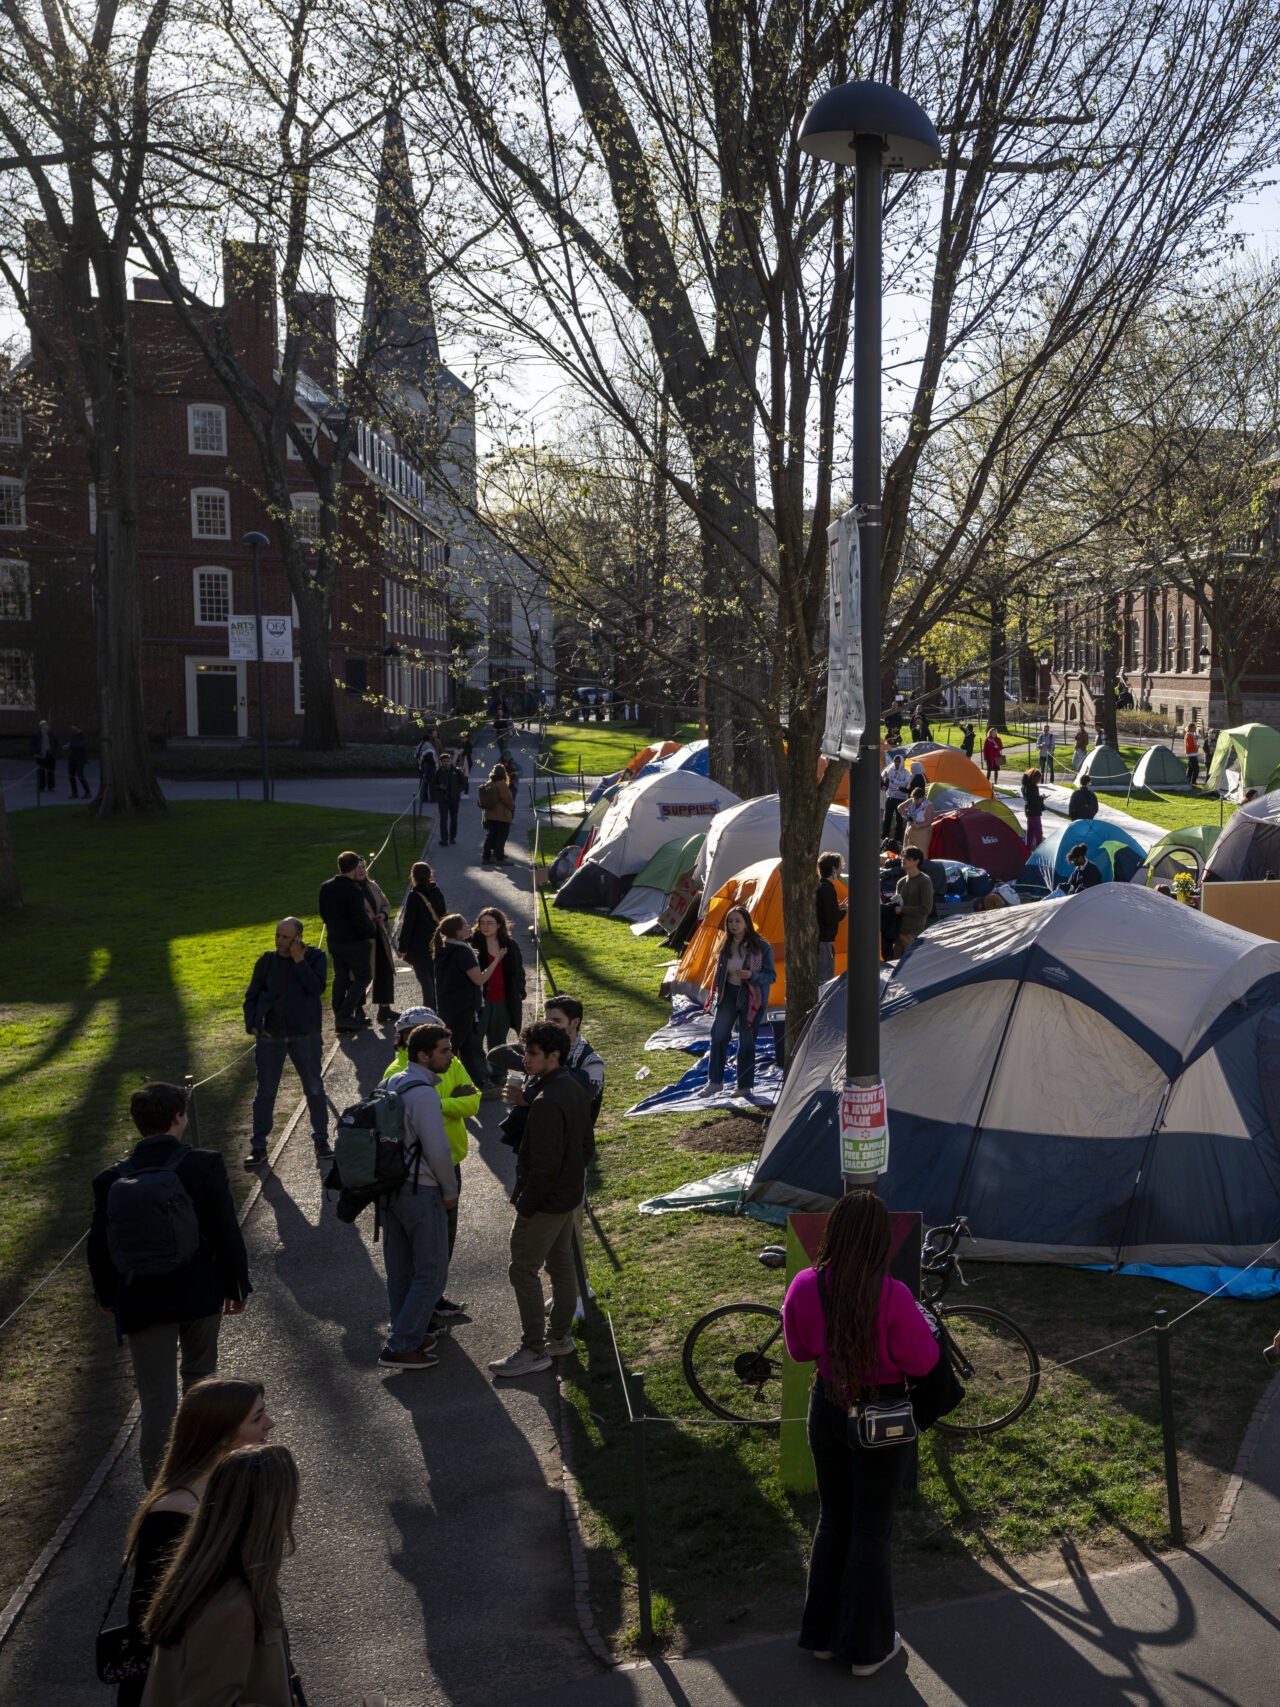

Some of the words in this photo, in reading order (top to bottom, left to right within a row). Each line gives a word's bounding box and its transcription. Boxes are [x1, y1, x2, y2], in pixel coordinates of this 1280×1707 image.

[843, 1091, 877, 1103] DISSENT
[878, 1088, 884, 1099] IS
[844, 1105, 849, 1113] A
[852, 1102, 881, 1114] JEWISH
[844, 1115, 871, 1126] VALUE
[845, 1141, 853, 1150] NO
[859, 1140, 884, 1151] CAMPUS
[845, 1151, 860, 1160] FREE
[862, 1149, 884, 1159] SPEECH
[845, 1157, 884, 1169] CRACKDOWN
